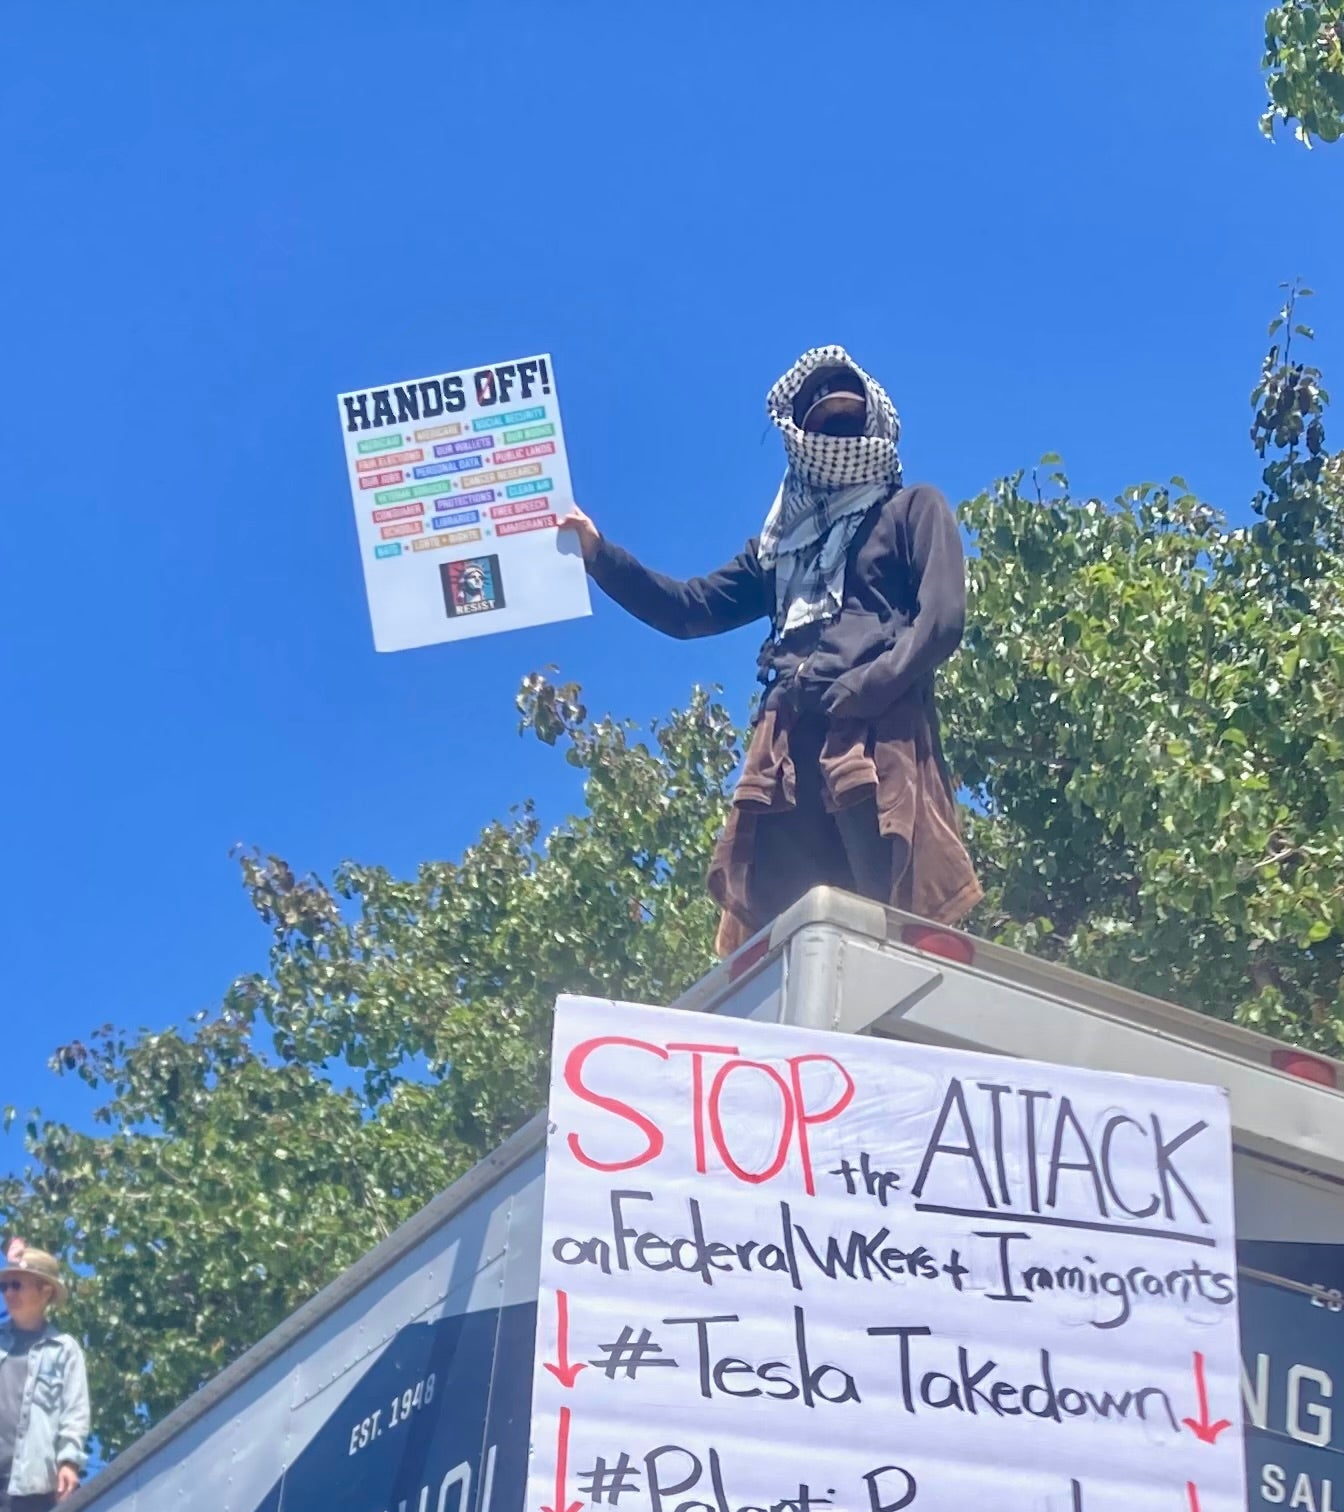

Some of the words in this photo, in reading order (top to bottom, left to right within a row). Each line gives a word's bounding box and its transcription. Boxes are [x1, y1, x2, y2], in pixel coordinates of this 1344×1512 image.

[343, 374, 467, 432] HANDS
[473, 358, 551, 407] OFF!
[495, 448, 524, 462] PUBLIC
[455, 599, 496, 616] RESIST
[563, 1036, 858, 1196] STOP
[829, 1151, 902, 1206] the
[910, 1076, 1212, 1225] ATTACK
[973, 1230, 1238, 1330] Immigrants
[347, 1419, 384, 1458] EST.
[388, 1373, 437, 1430] 1948
